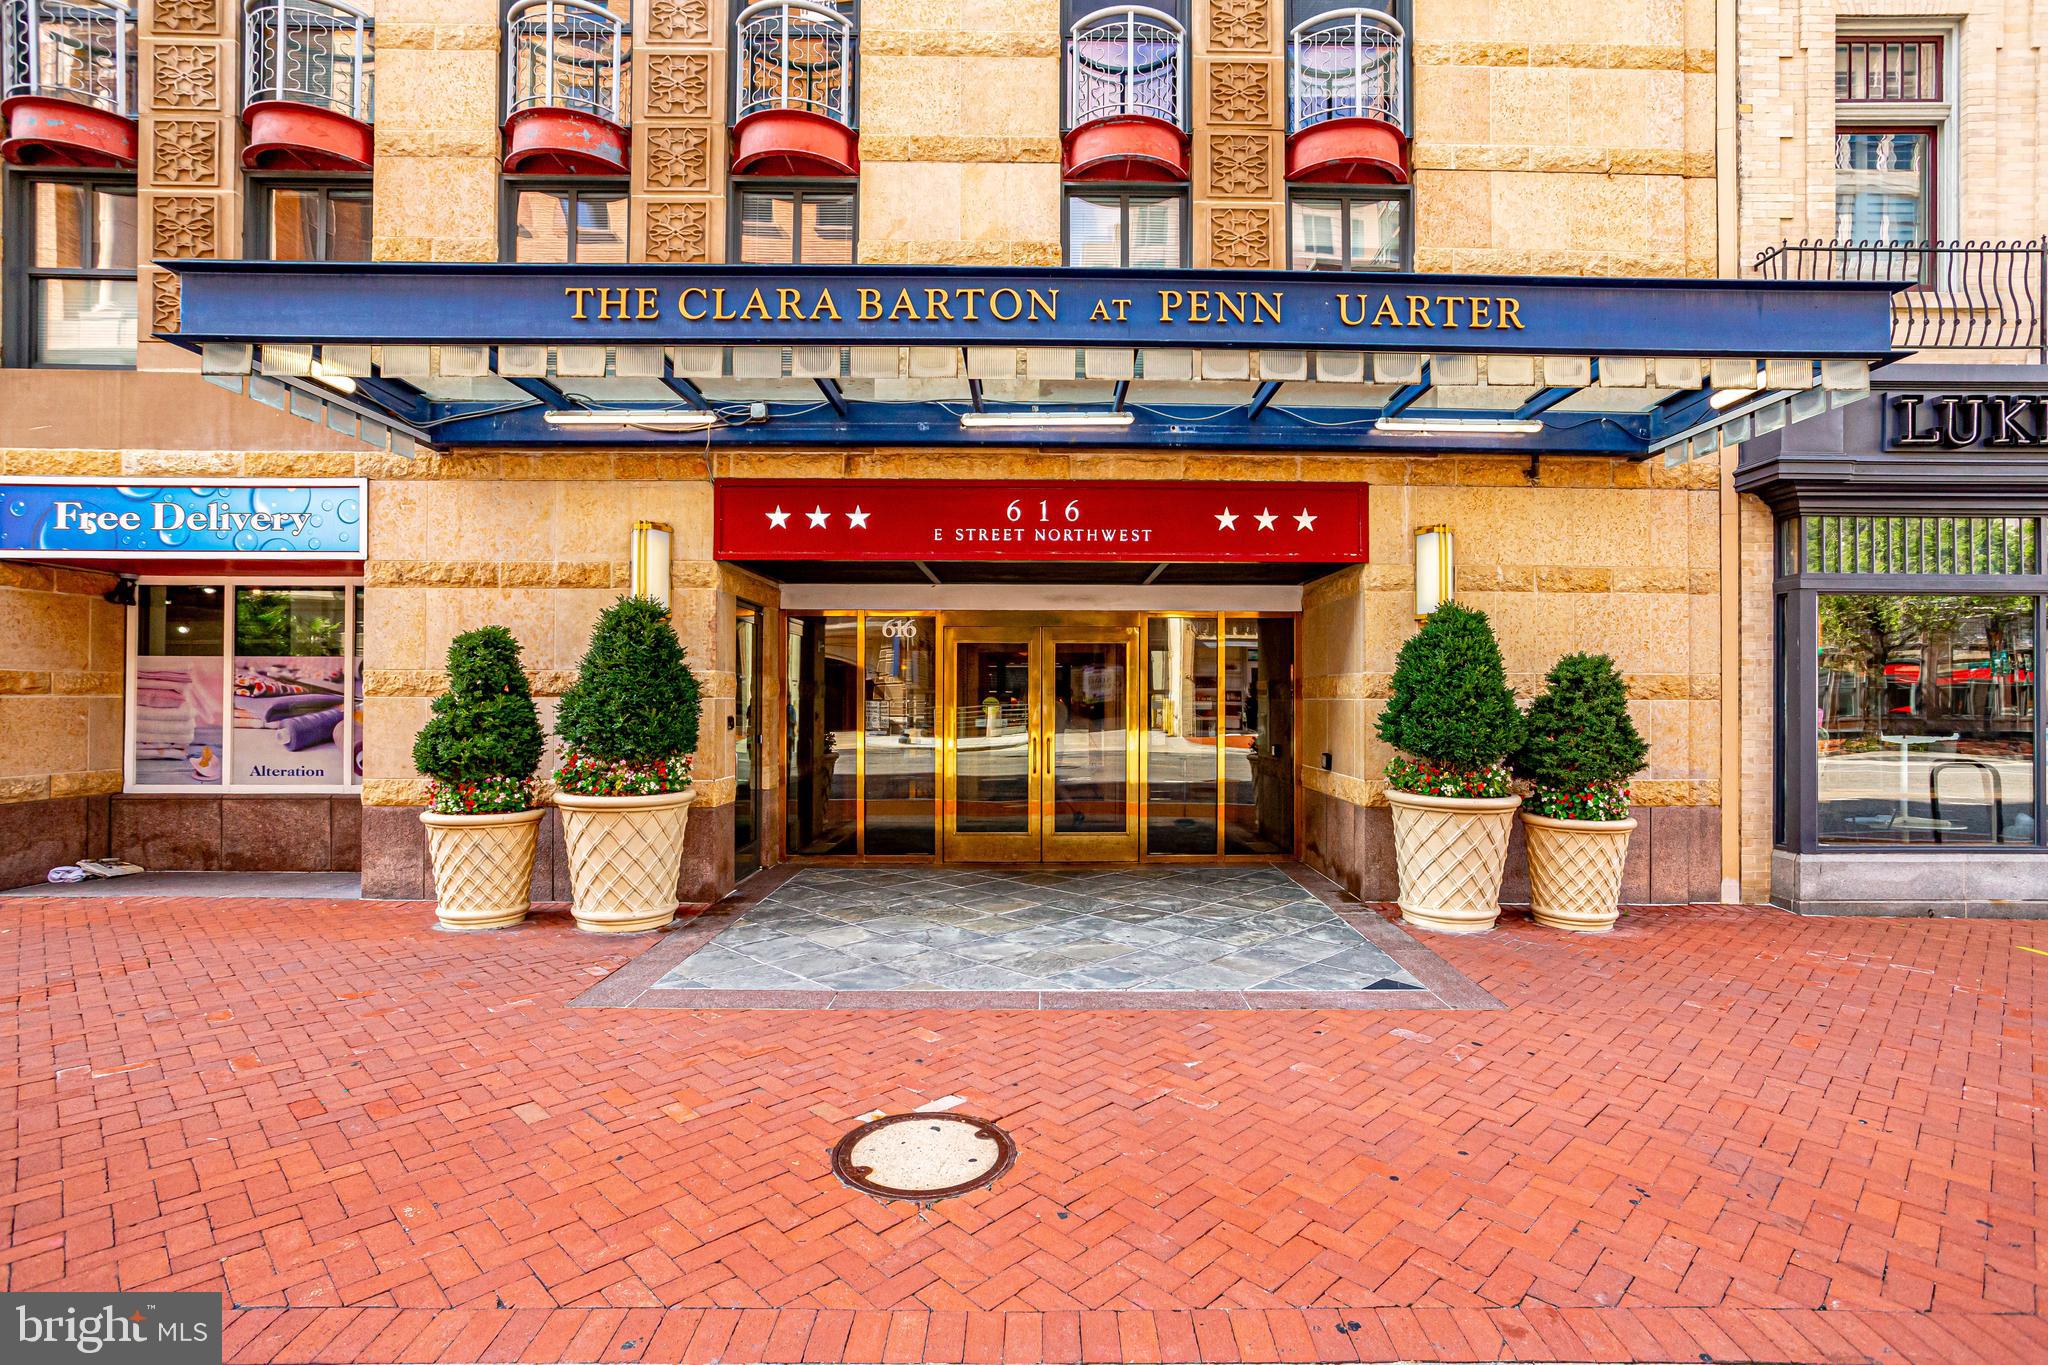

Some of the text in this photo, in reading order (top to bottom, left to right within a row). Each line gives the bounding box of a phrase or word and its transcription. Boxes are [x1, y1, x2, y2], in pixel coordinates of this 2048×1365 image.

[564, 287, 1526, 330] THE CLARA BARTON AT PENN UARTER
[1900, 394, 2048, 450] LUK
[53, 500, 312, 537] Free Delivery
[933, 528, 1153, 542] E STREET NORTHWEST
[881, 618, 917, 638] 616
[249, 765, 325, 777] Alteration
